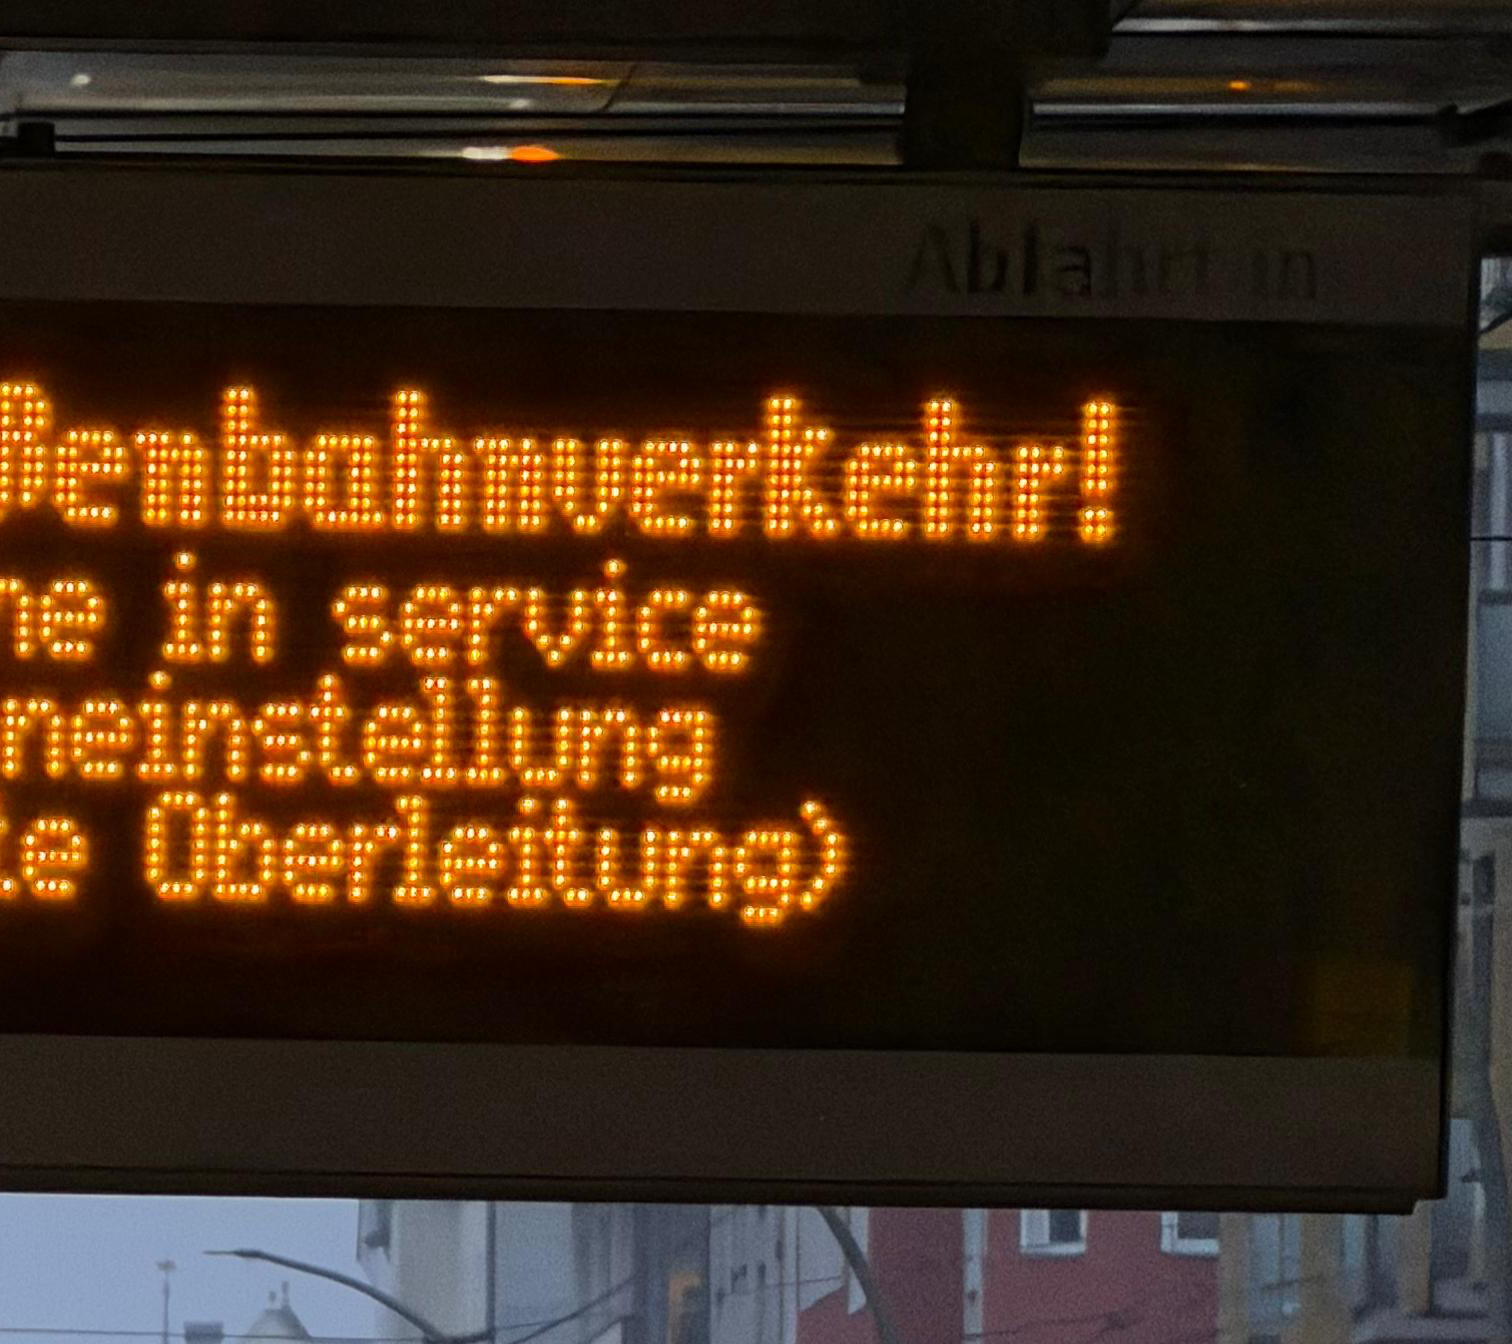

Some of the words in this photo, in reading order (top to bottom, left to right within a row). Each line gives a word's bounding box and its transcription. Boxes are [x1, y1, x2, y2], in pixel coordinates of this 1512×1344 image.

[155, 548, 276, 663] in
[332, 556, 763, 672] service
[142, 789, 847, 926] Oberleitung)
